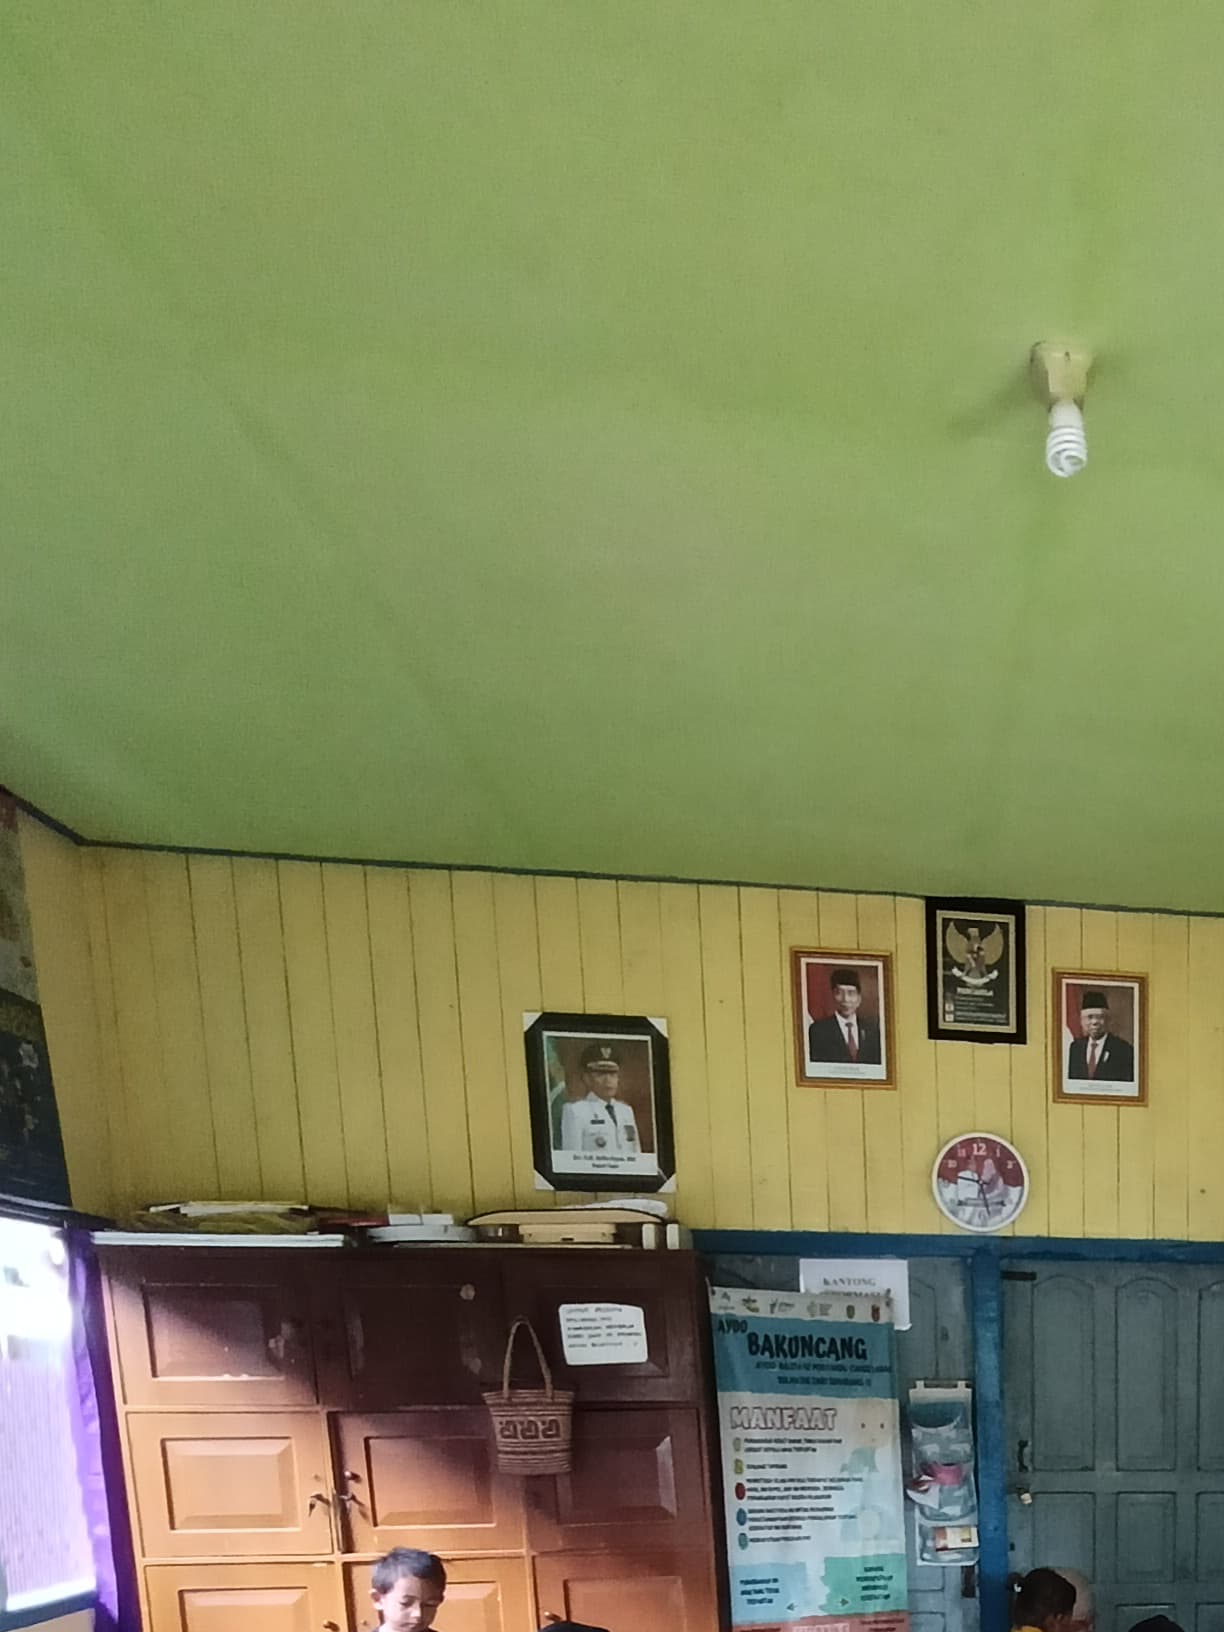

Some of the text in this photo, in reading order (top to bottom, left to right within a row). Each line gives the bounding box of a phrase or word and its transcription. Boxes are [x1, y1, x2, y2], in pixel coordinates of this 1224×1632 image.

[972, 1143, 987, 1156] 12
[823, 1277, 876, 1287] KANTONG
[747, 1332, 868, 1361] BAKUNCANG
[731, 1407, 838, 1430] MANFAAT
